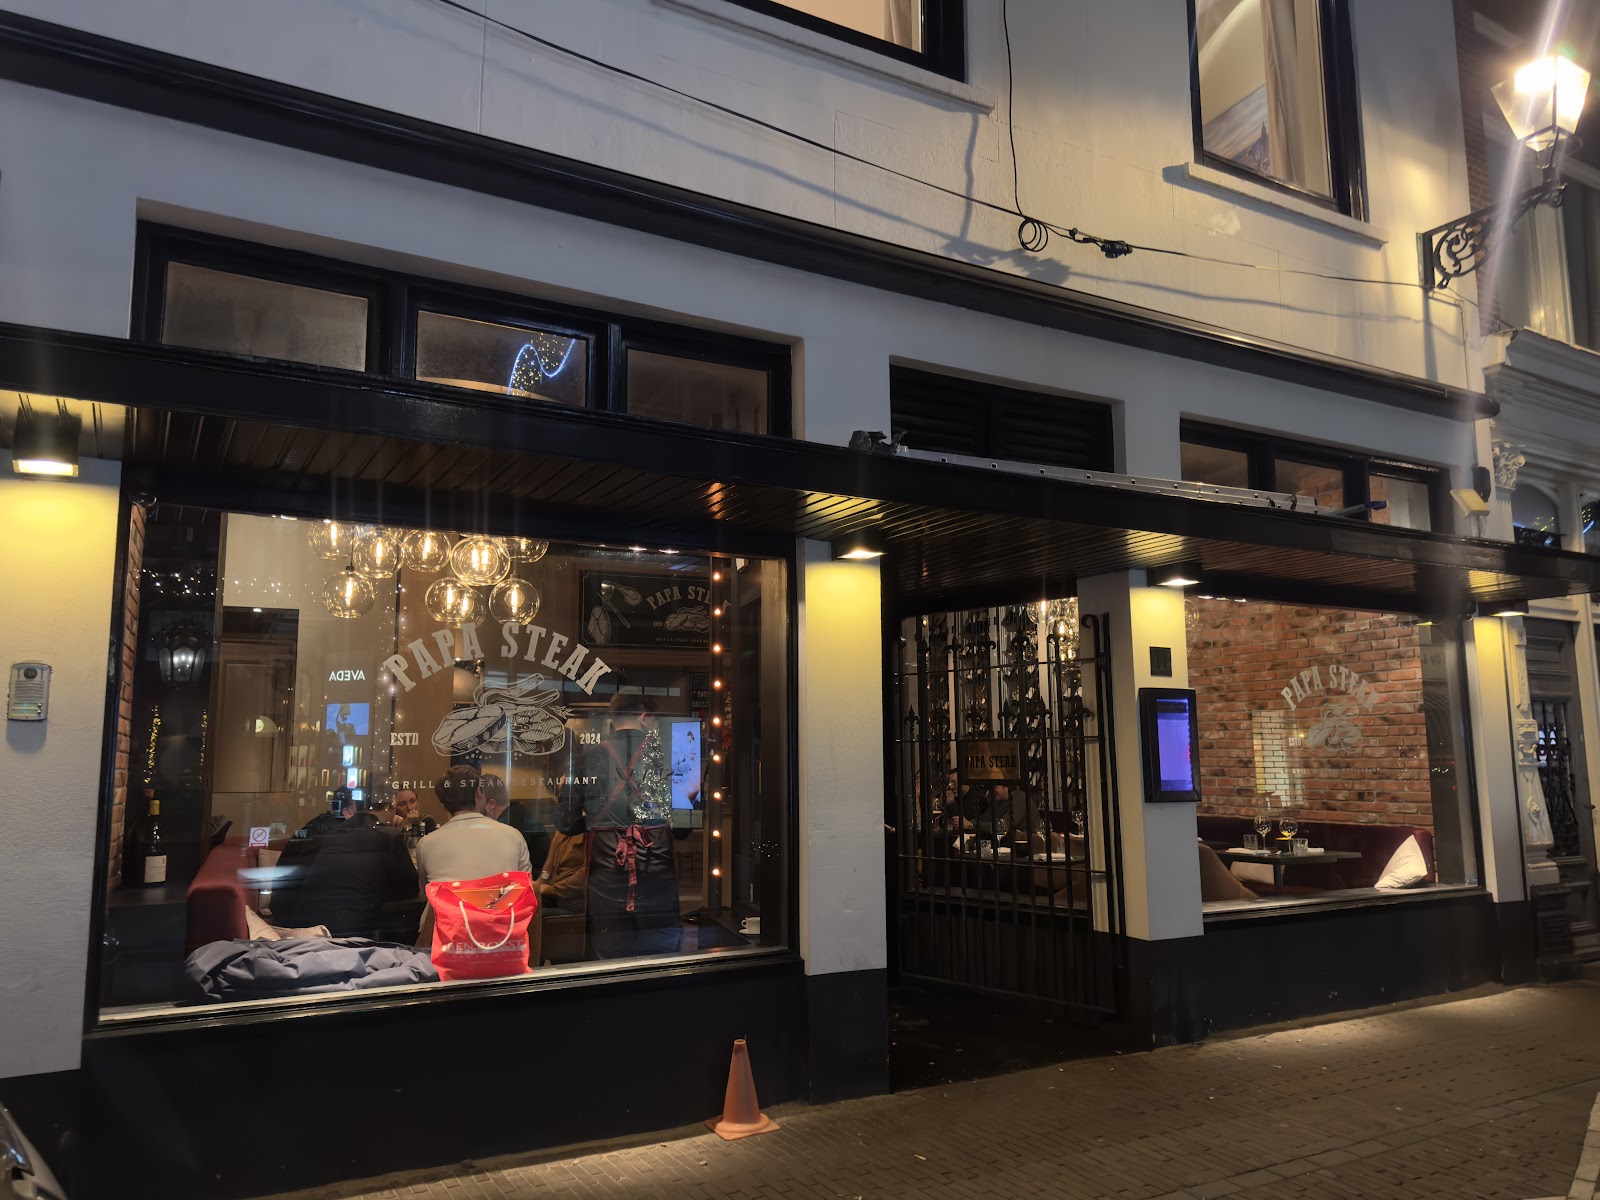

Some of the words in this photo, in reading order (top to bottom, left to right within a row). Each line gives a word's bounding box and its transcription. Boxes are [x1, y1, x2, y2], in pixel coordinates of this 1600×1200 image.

[646, 585, 682, 610] PAPA
[382, 622, 485, 692] PAPA
[500, 621, 612, 696] STEAK
[1280, 665, 1323, 711] PAPA
[389, 732, 419, 746] ESTD
[579, 732, 601, 745] 2024
[988, 754, 1017, 768] STEAK
[391, 780, 435, 790] GRILL
[443, 779, 451, 788] &
[460, 778, 504, 788] STEAK
[511, 776, 598, 787] ESTAURANT
